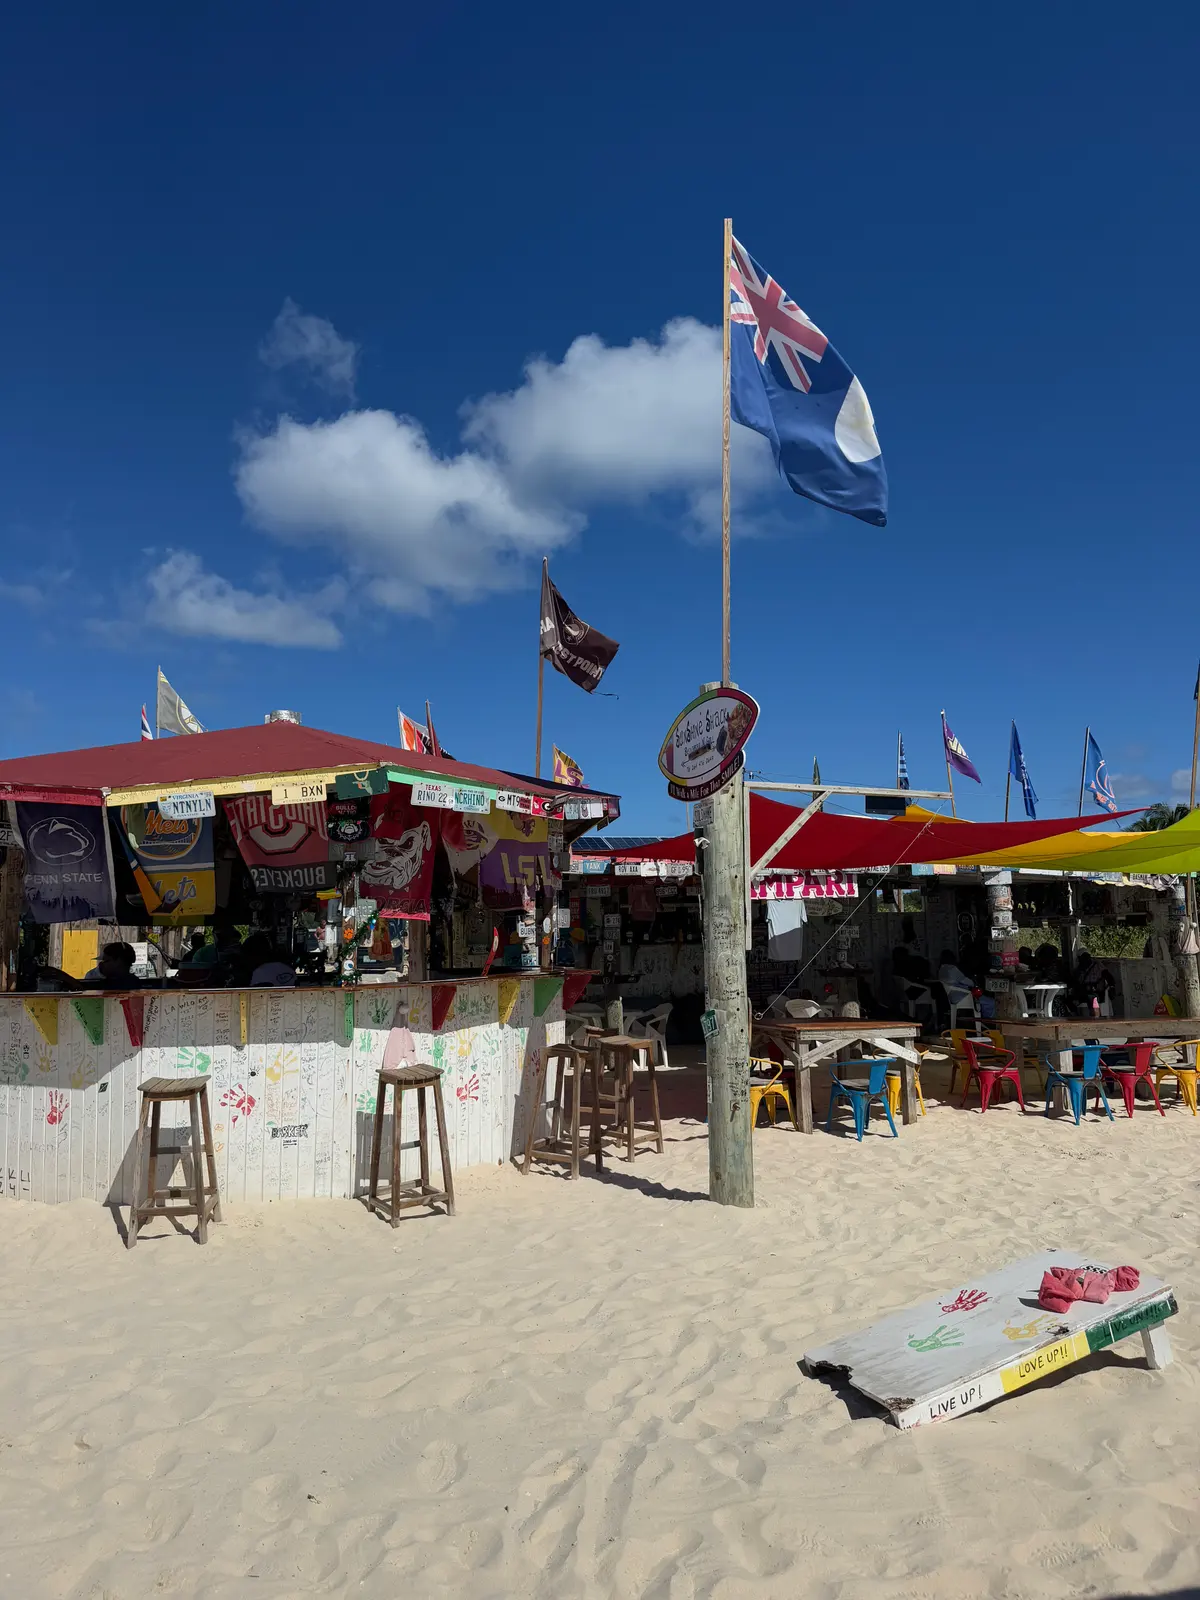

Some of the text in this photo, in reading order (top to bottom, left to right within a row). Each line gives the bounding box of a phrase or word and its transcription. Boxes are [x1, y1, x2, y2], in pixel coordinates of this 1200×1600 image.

[301, 784, 323, 798] BXN
[425, 784, 441, 792] TEXAS
[172, 792, 199, 800] VIRGINIA
[172, 799, 212, 815] NTNYLN
[24, 871, 103, 885] PENN STATE
[1018, 1343, 1068, 1378] LOVE UP!!
[929, 1384, 983, 1419] LIVE UP!
